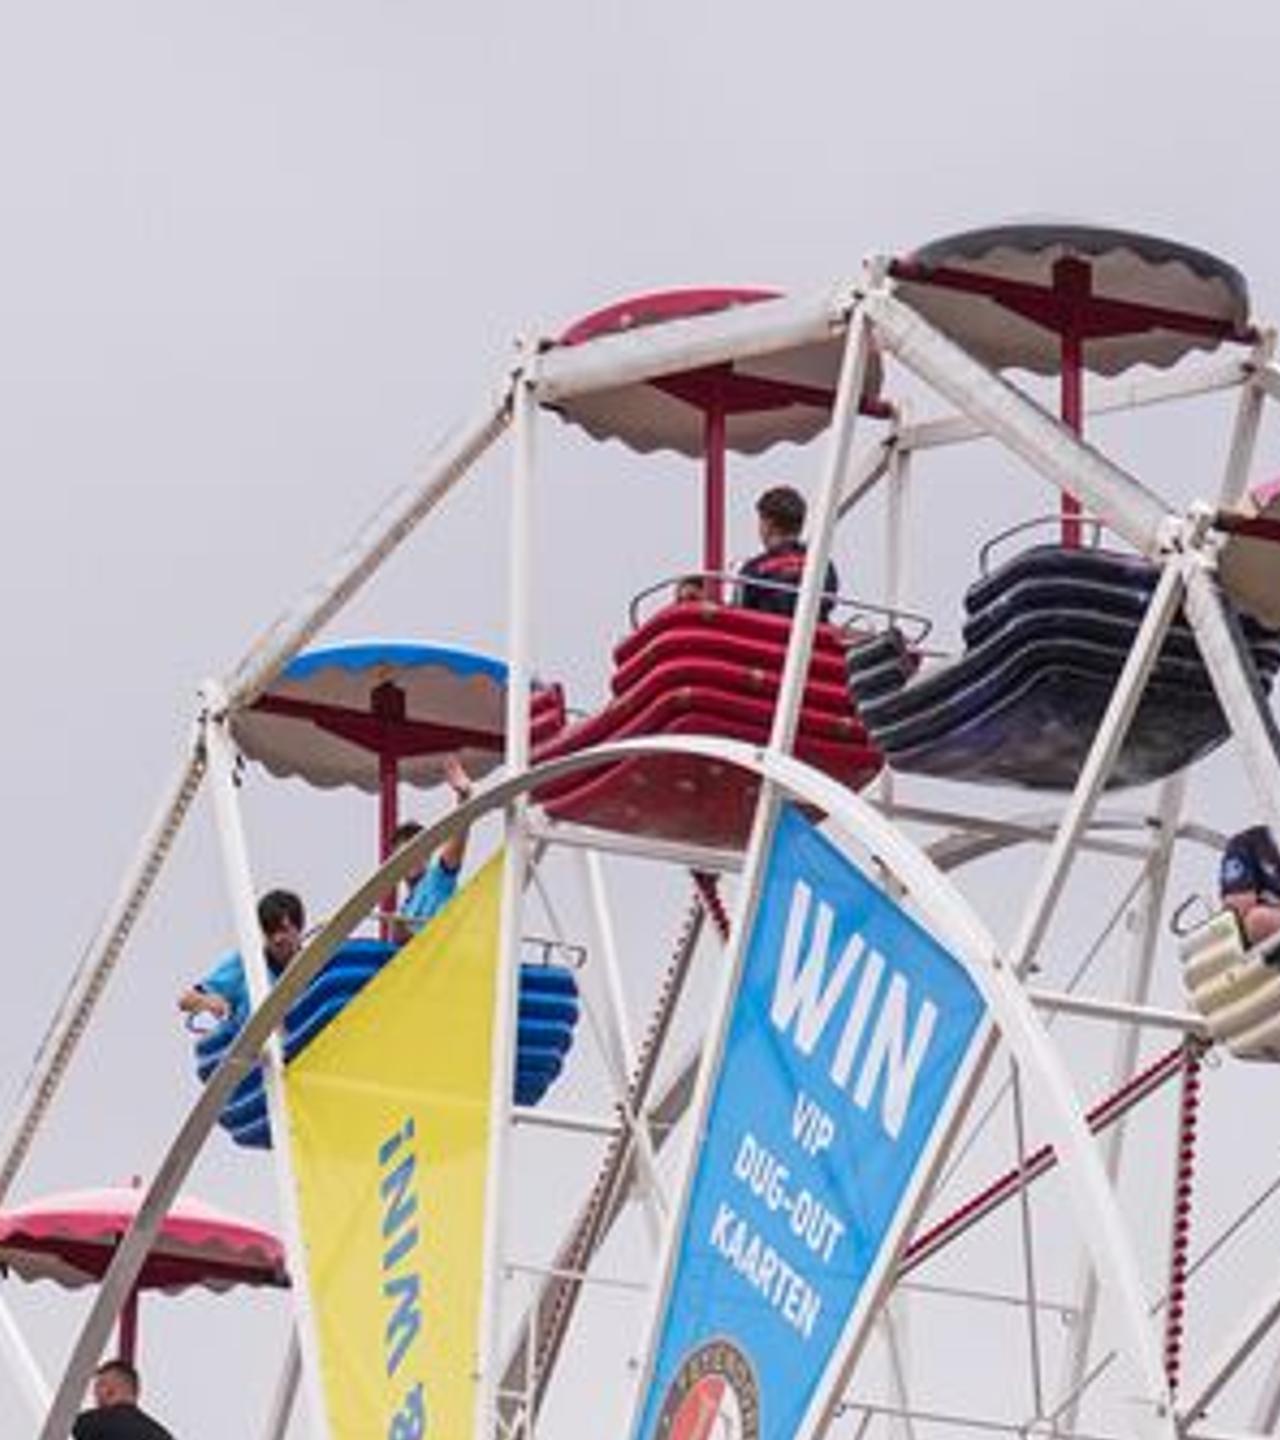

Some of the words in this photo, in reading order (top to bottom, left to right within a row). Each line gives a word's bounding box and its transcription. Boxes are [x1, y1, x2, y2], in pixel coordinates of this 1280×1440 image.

[770, 878, 938, 1140] WIN
[791, 1091, 836, 1157] VIP
[378, 1115, 421, 1377] WIN!
[733, 1132, 845, 1263] DUG-OUT
[709, 1202, 822, 1340] KAARTEN
